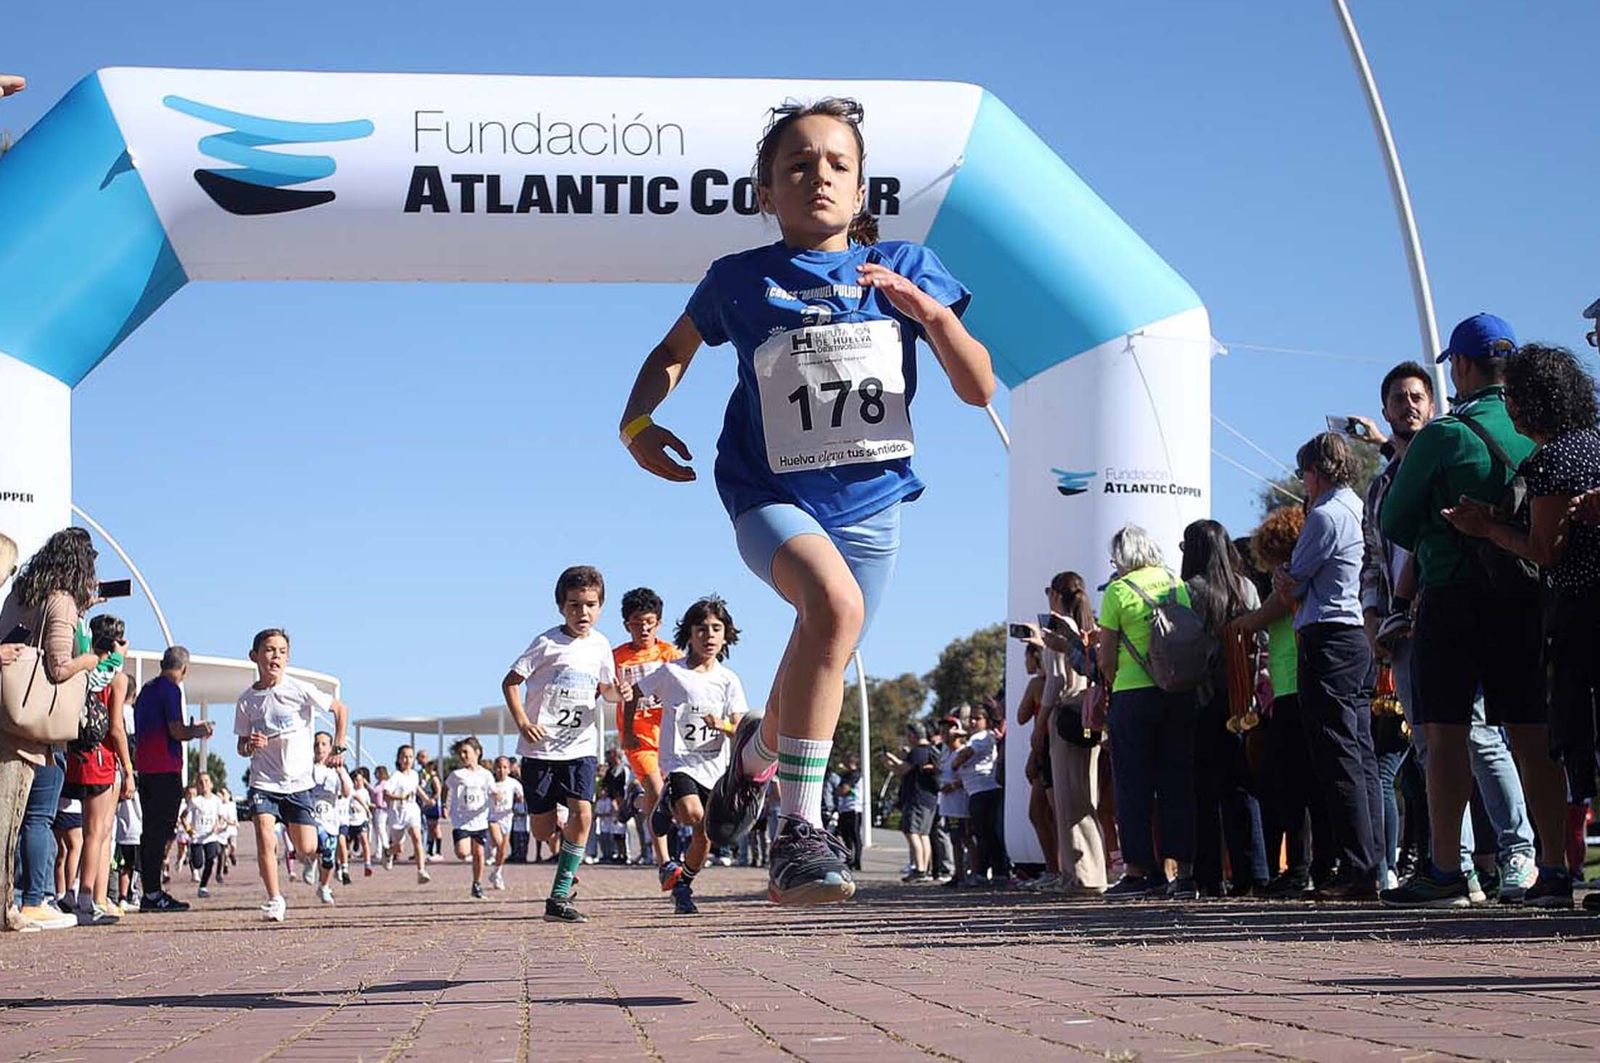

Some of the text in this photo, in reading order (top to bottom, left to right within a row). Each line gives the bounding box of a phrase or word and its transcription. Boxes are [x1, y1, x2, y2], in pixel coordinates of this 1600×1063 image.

[414, 111, 684, 156] Fundación
[403, 165, 901, 216] ATLANTIC COR
[788, 377, 886, 432] 178
[780, 453, 816, 467] Huelva
[818, 450, 844, 463] eleva
[847, 449, 865, 459] tus
[1104, 482, 1201, 497] ATLANTIC COPPER
[556, 709, 583, 729] 25
